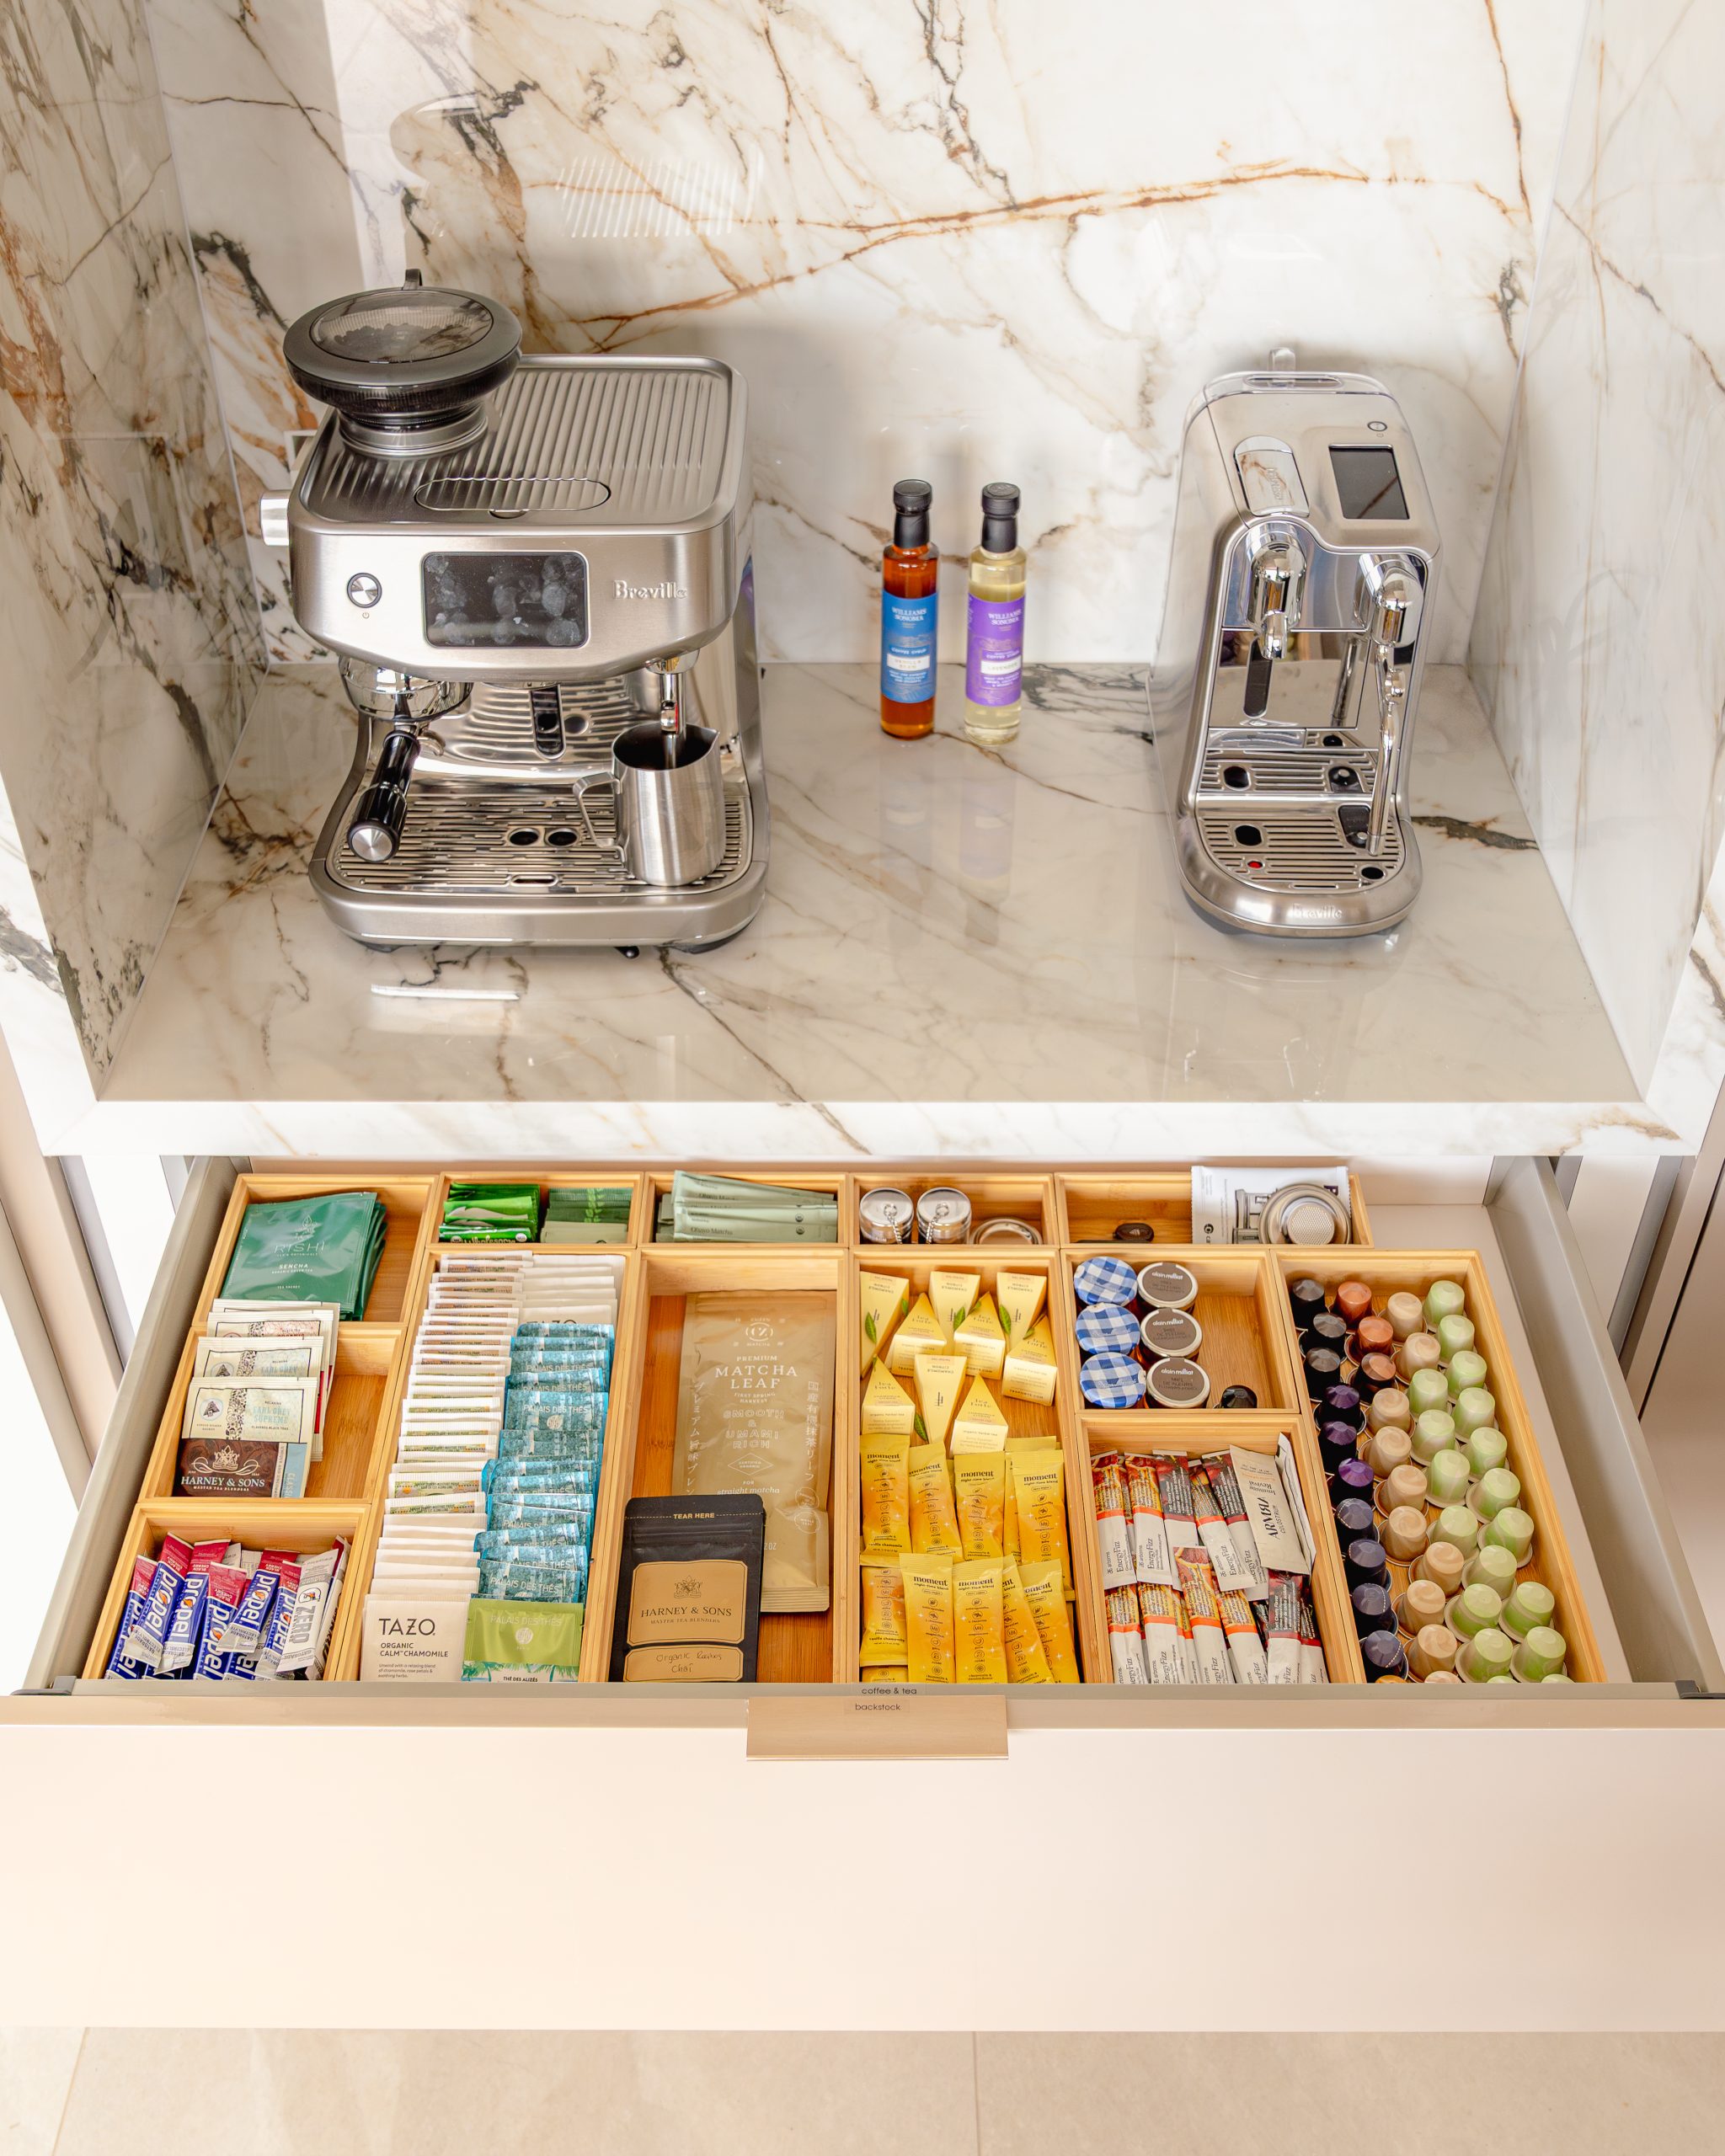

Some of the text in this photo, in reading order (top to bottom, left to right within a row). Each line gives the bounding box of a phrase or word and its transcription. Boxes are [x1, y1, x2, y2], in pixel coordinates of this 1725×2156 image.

[612, 579, 688, 600] Breville
[891, 606, 927, 616] WILLIAMS
[988, 609, 1022, 620] WILLIAMS
[894, 614, 924, 622] SONOMA
[991, 616, 1019, 625] SONOMA
[711, 1227, 734, 1235] Matcha
[715, 1364, 798, 1378] MATCHA
[730, 1378, 781, 1390] LEAF
[524, 1405, 551, 1413] PALAIS
[552, 1405, 567, 1413] DES
[254, 1416, 288, 1424] SUPREME
[725, 1429, 779, 1439] UMAMI
[733, 1439, 770, 1449] RICH
[909, 1463, 942, 1476] moment
[181, 1476, 265, 1487] HARNEY & SONS
[1023, 1473, 1058, 1482] moment
[1248, 1480, 1273, 1490] Revival
[1248, 1485, 1276, 1496] Immune
[1273, 1504, 1287, 1534] COLOSTRUM
[1104, 1550, 1113, 1567] arbonne
[1113, 1540, 1124, 1572] EnergyFizz
[1146, 1538, 1156, 1569] EnergyFizz
[167, 1560, 180, 1572] BLACK
[1220, 1545, 1237, 1576] EnergyFizz
[491, 1577, 519, 1587] PALAIS
[521, 1582, 537, 1591] DES
[913, 1576, 948, 1587] moment
[959, 1577, 994, 1587] moment
[214, 1588, 232, 1599] CHERRY
[216, 1593, 231, 1603] BLACK
[145, 1566, 178, 1638] propel
[240, 1574, 277, 1627] propel
[170, 1577, 204, 1637] propel
[641, 1606, 688, 1618] HARNEY
[702, 1606, 732, 1617] SONS
[295, 1604, 317, 1644] ZERO
[491, 1615, 520, 1625] PALAIS
[656, 1652, 691, 1664] Organic
[855, 1702, 901, 1711] backstock
